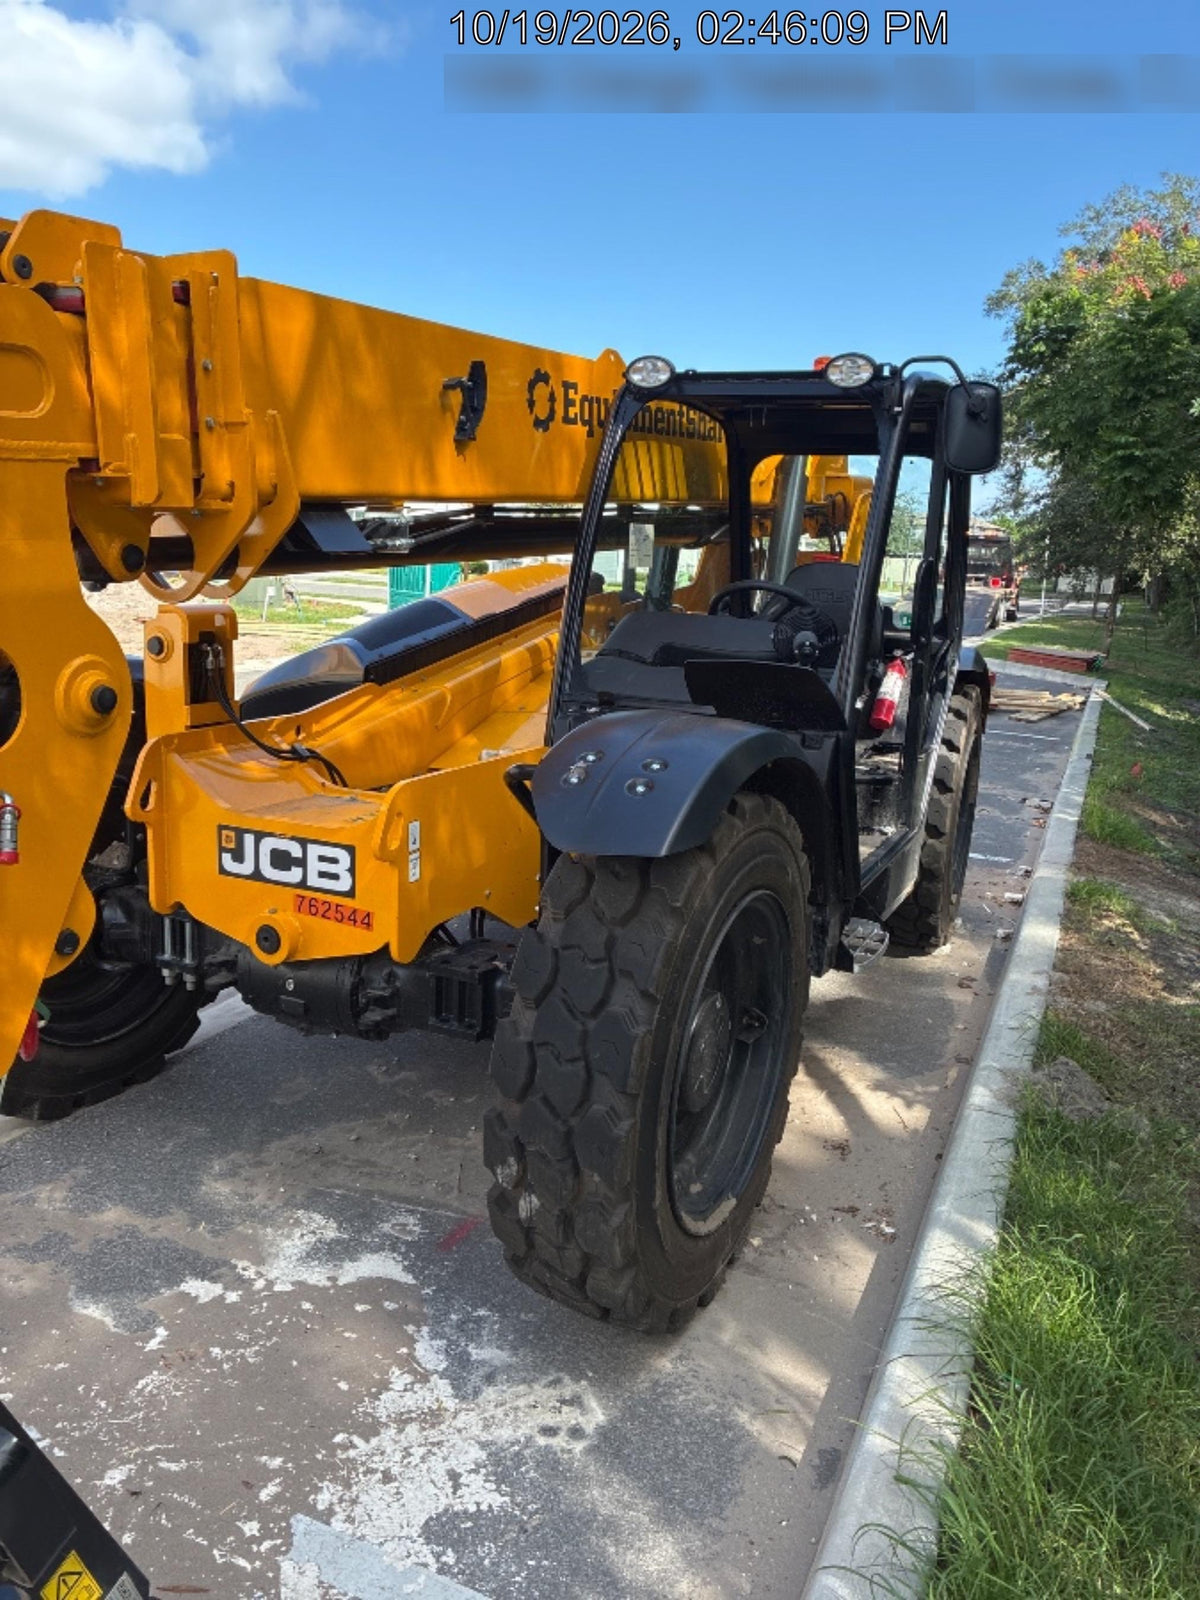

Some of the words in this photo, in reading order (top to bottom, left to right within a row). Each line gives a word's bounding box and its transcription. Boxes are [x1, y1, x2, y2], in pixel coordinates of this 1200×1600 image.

[561, 380, 725, 443] EqumentShar
[221, 833, 353, 892] JCB
[296, 895, 373, 929] 762544
